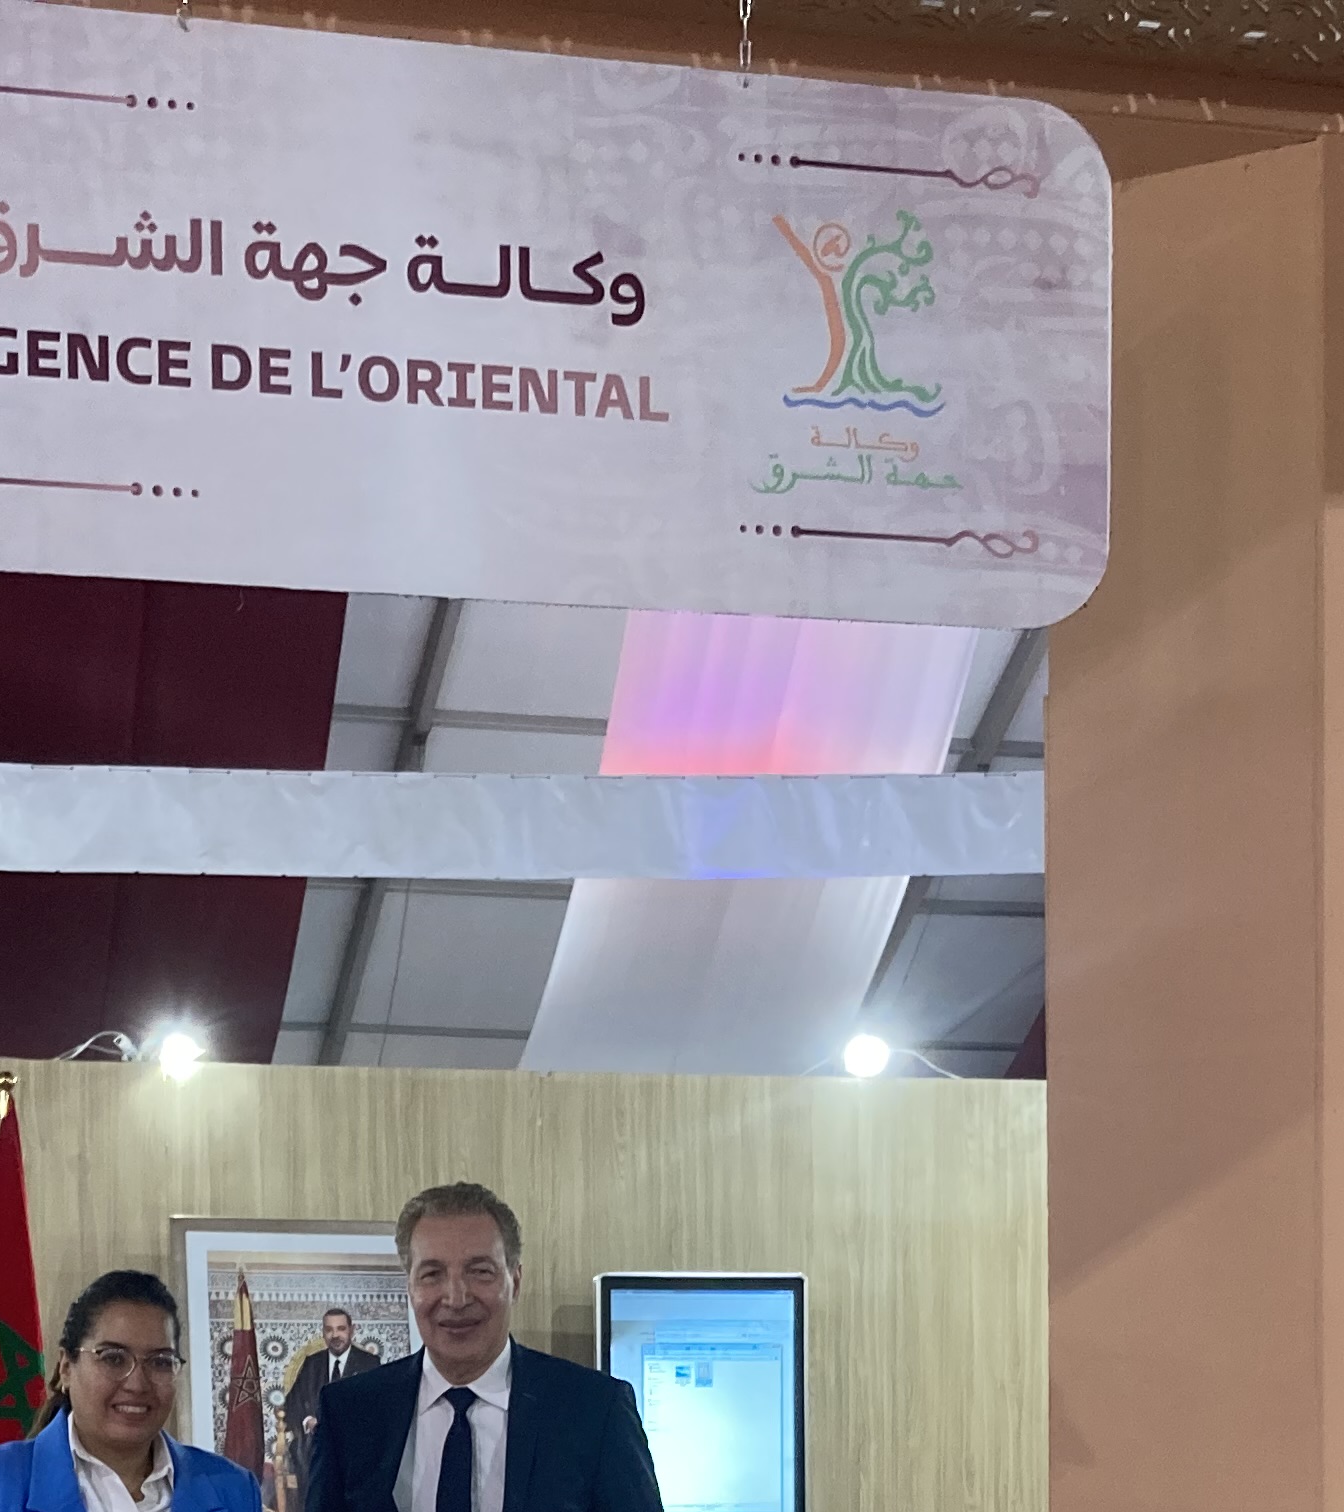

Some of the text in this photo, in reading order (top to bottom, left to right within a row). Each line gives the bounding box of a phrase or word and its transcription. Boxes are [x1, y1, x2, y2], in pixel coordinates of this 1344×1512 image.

[244, 220, 387, 307] جهة
[406, 234, 646, 327] وكالة
[211, 343, 292, 395] DE
[311, 351, 669, 422] L'ORIENTAL
[747, 453, 872, 494] الشرق
[810, 425, 920, 463] وكالة
